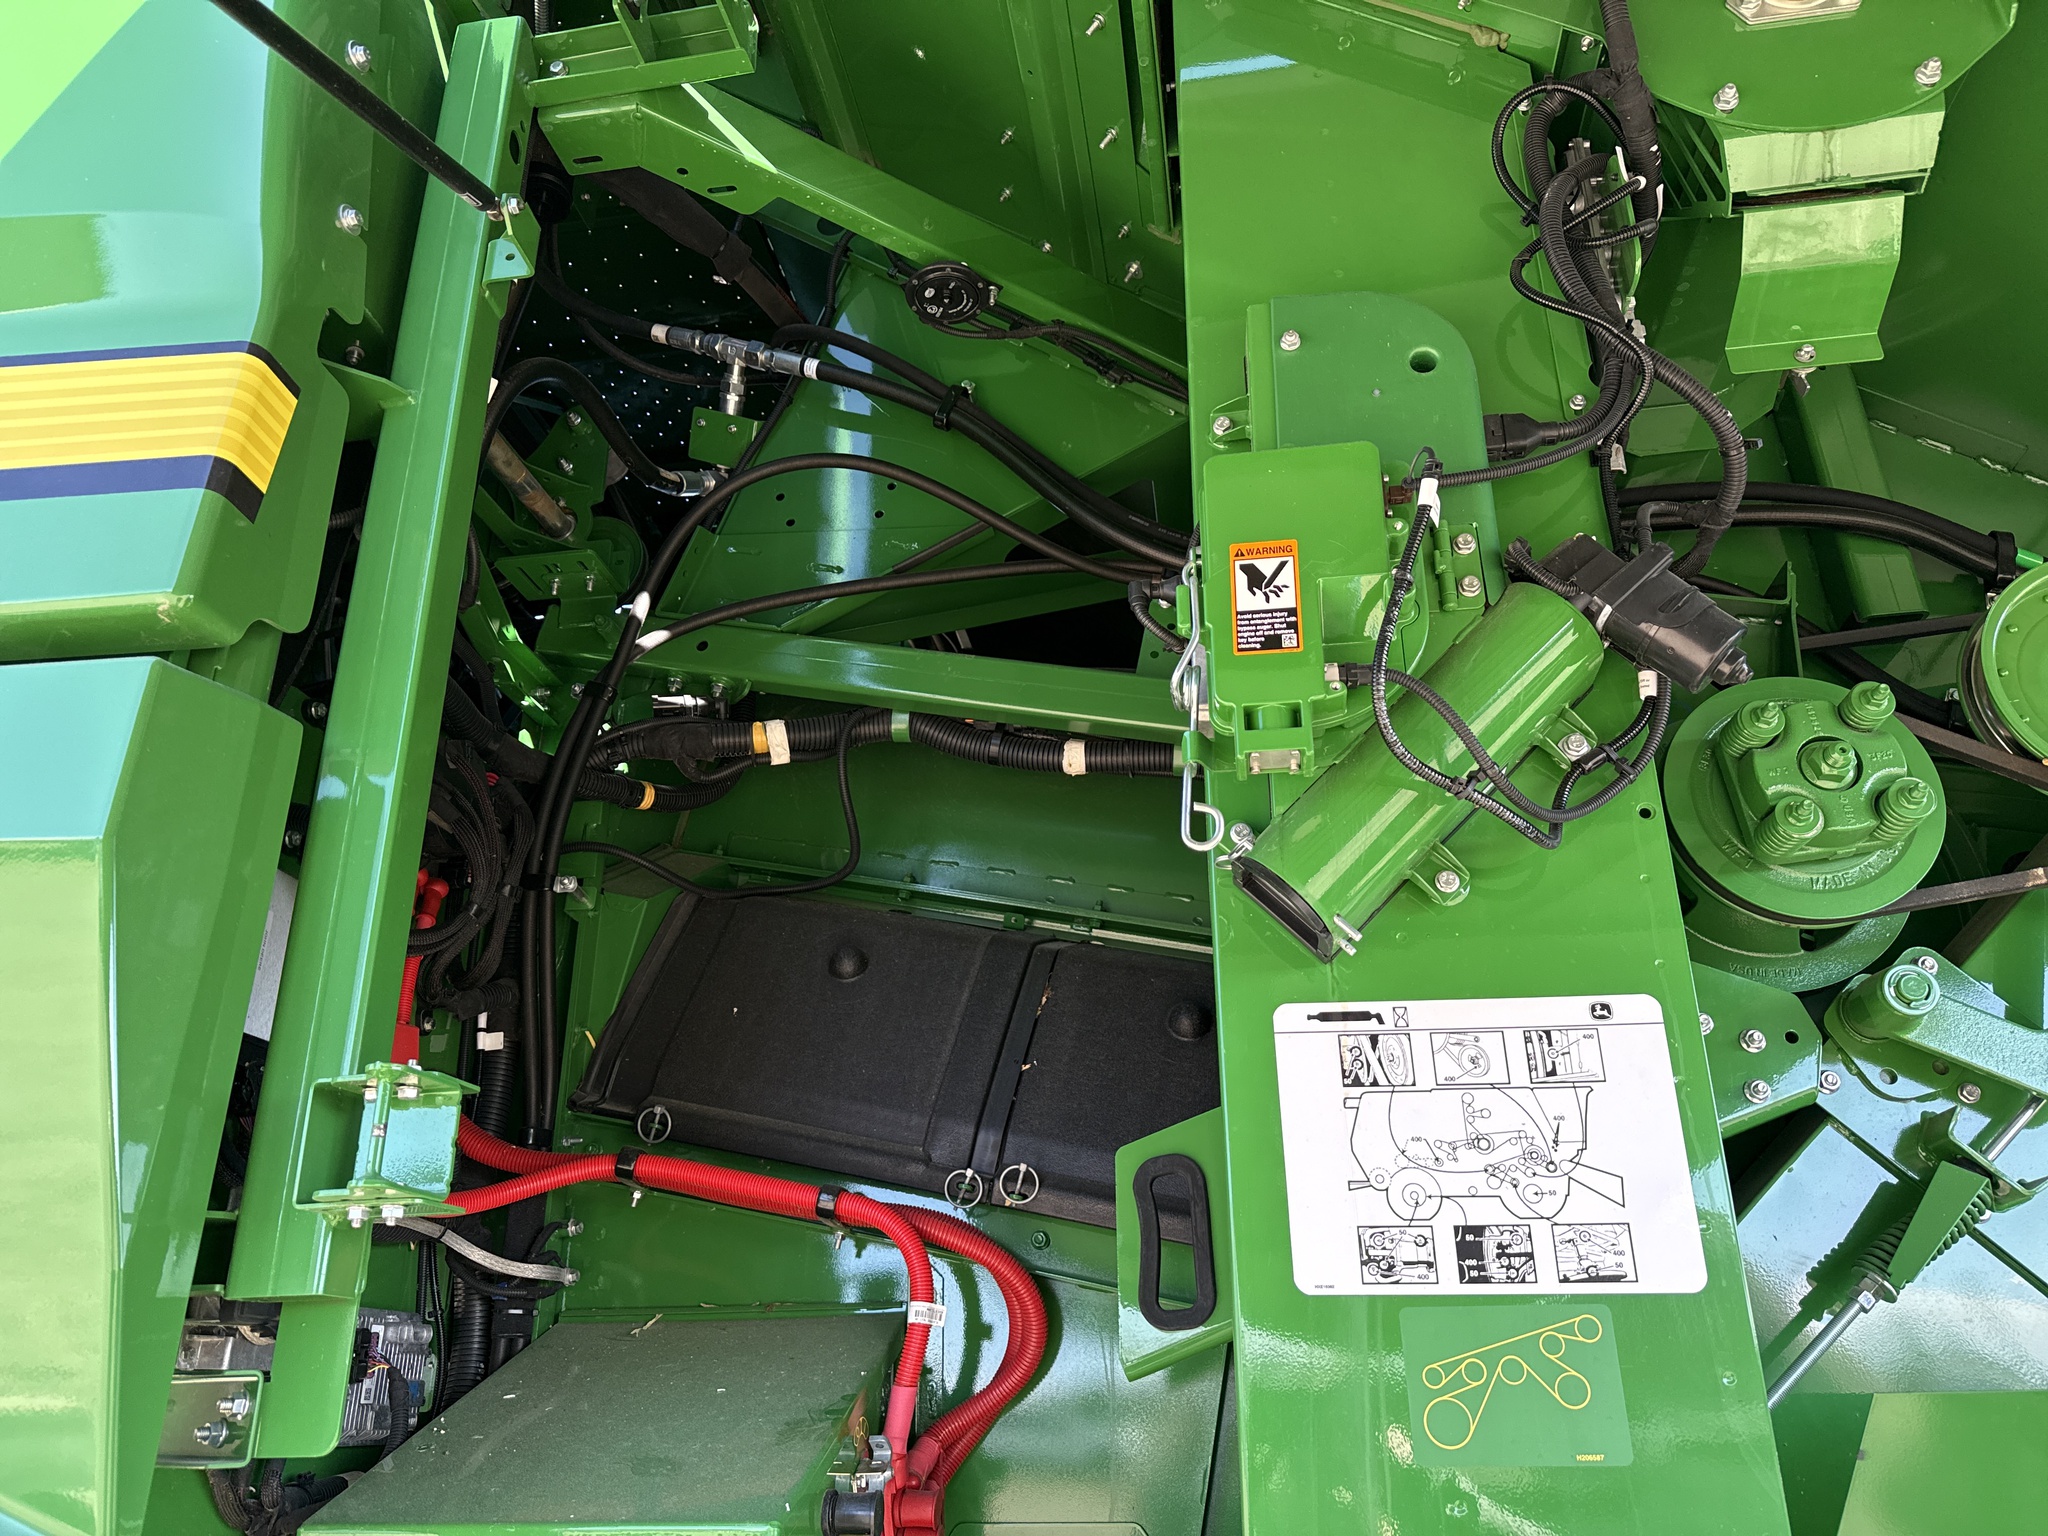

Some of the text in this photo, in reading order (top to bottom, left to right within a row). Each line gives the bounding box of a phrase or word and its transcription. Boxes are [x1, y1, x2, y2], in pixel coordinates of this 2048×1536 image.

[1245, 544, 1293, 556] WARNING
[1809, 871, 1857, 890] MADE
[1729, 962, 1754, 976] USA
